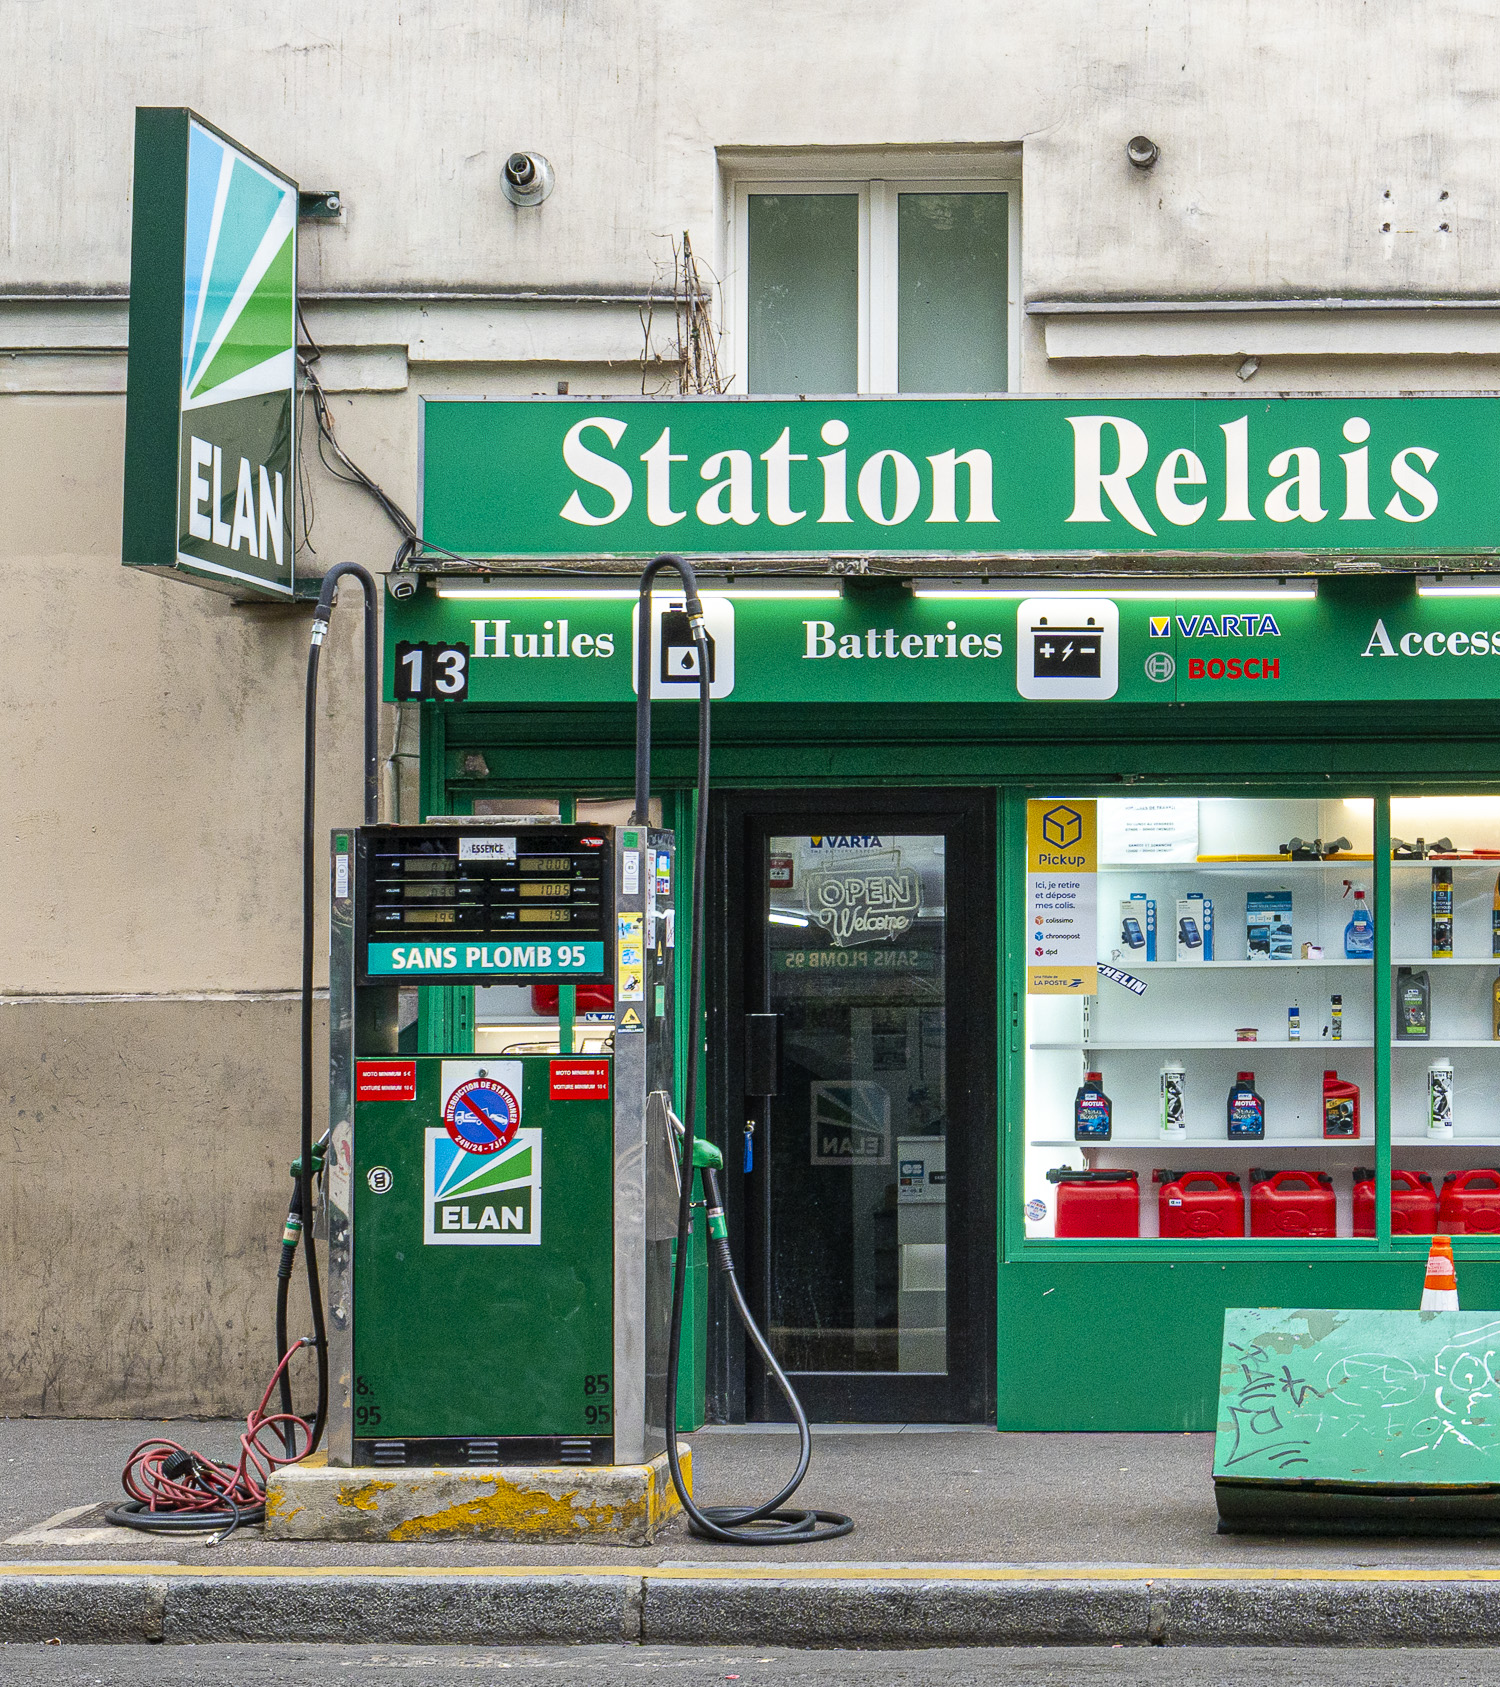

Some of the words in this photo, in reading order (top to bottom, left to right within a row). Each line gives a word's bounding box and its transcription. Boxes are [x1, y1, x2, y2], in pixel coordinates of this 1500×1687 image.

[560, 415, 1001, 527] Station
[1064, 413, 1440, 537] Relais
[189, 435, 285, 566] ELAN
[1176, 613, 1281, 638] VARTA
[469, 619, 615, 659] Huiles
[802, 619, 1004, 660] Batteries
[401, 649, 467, 694] 13
[1188, 658, 1280, 680] BOSCH
[471, 844, 504, 854] ESSENCE
[826, 836, 882, 848] VARTA
[1039, 854, 1086, 867] Pickup
[818, 876, 910, 908] OPEN
[1035, 882, 1046, 890] Ici,
[1047, 882, 1056, 890] je
[1046, 892, 1076, 900] dépose
[819, 906, 909, 938] Welcome
[392, 946, 457, 970] SANS
[466, 946, 552, 968] PLOMB
[558, 946, 586, 968] 95
[1097, 965, 1147, 994] CHELIN
[446, 1081, 479, 1122] INTERDICTION
[491, 1084, 518, 1124] STATIONNER
[454, 1135, 483, 1152] 24H/24
[488, 1136, 507, 1151] 7J/7
[442, 1206, 524, 1230] ELAN
[584, 1374, 610, 1395] 85
[356, 1406, 381, 1426] 95
[584, 1404, 610, 1425] 95
